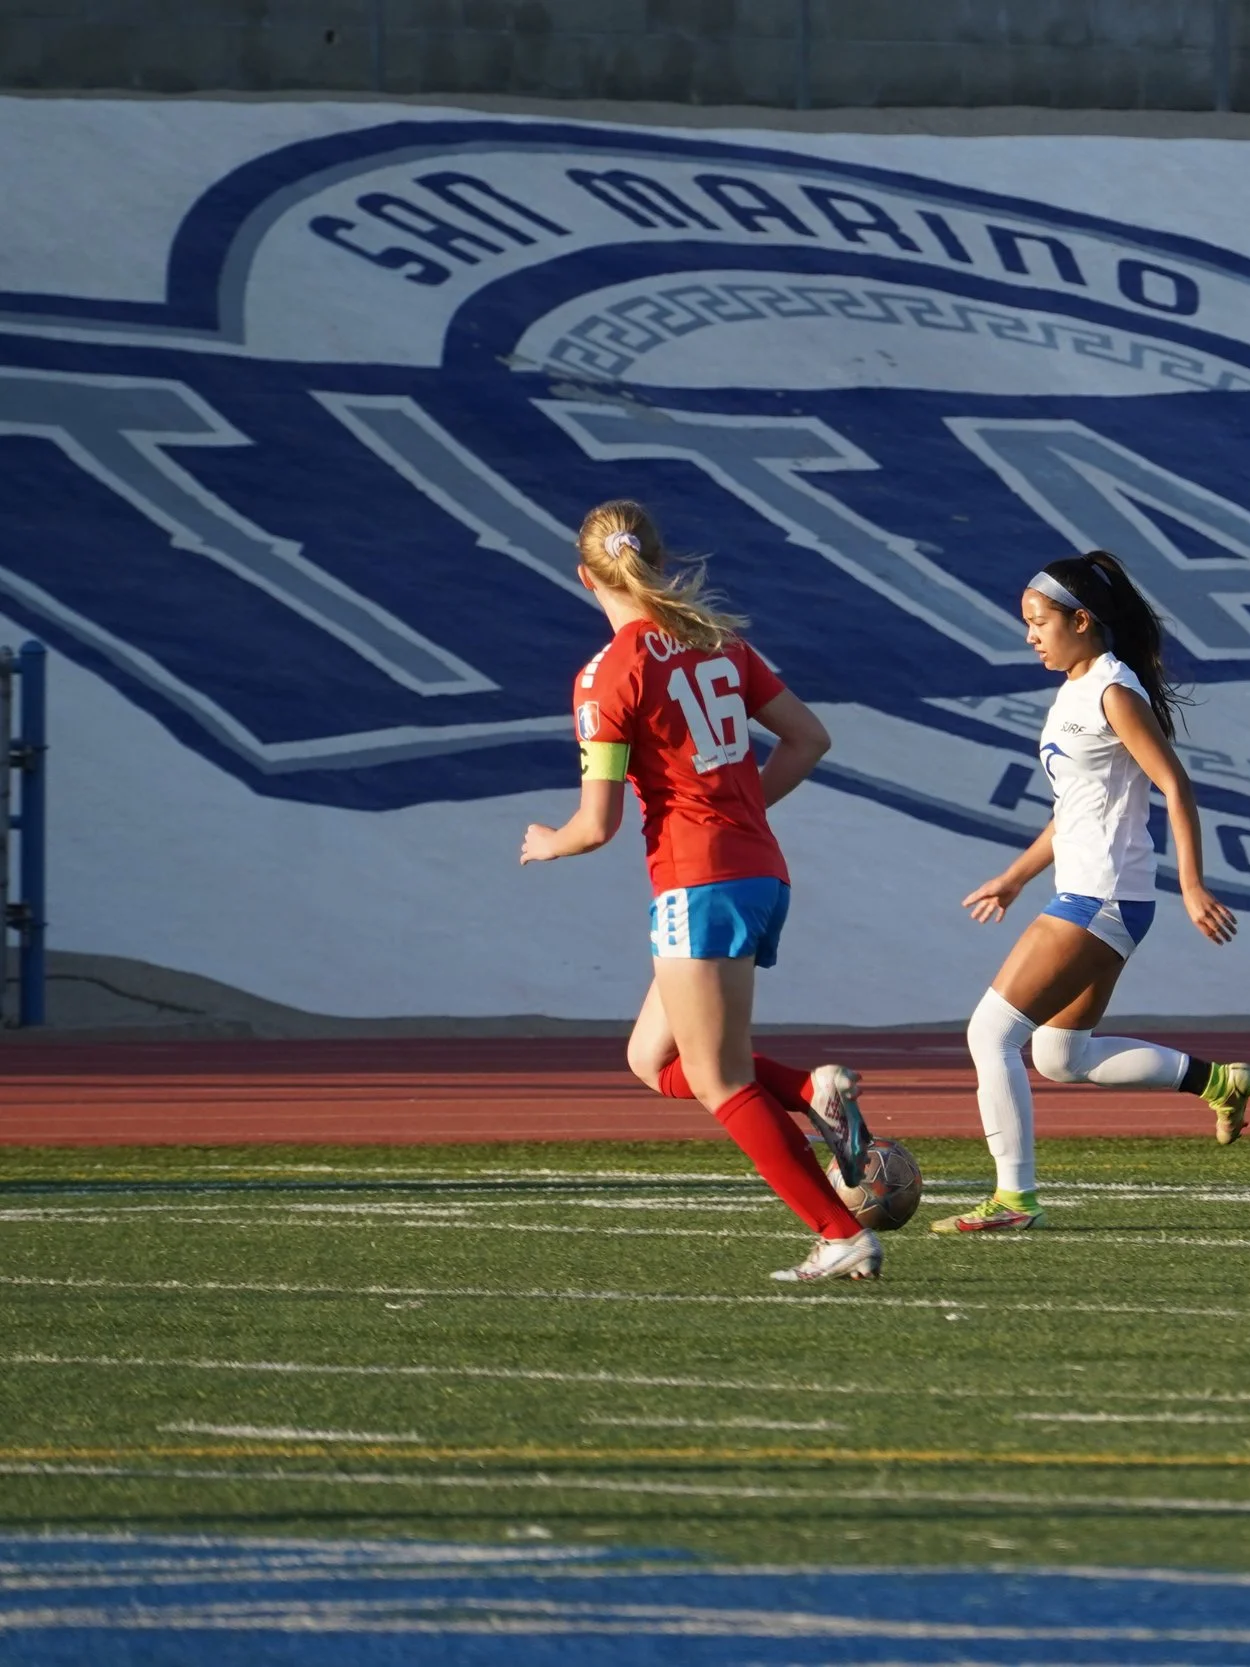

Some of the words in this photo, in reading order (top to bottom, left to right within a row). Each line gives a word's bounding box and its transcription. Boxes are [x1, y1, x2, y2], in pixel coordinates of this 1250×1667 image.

[308, 170, 573, 287] SAN
[565, 169, 1200, 316] MARINO
[667, 656, 750, 775] 16
